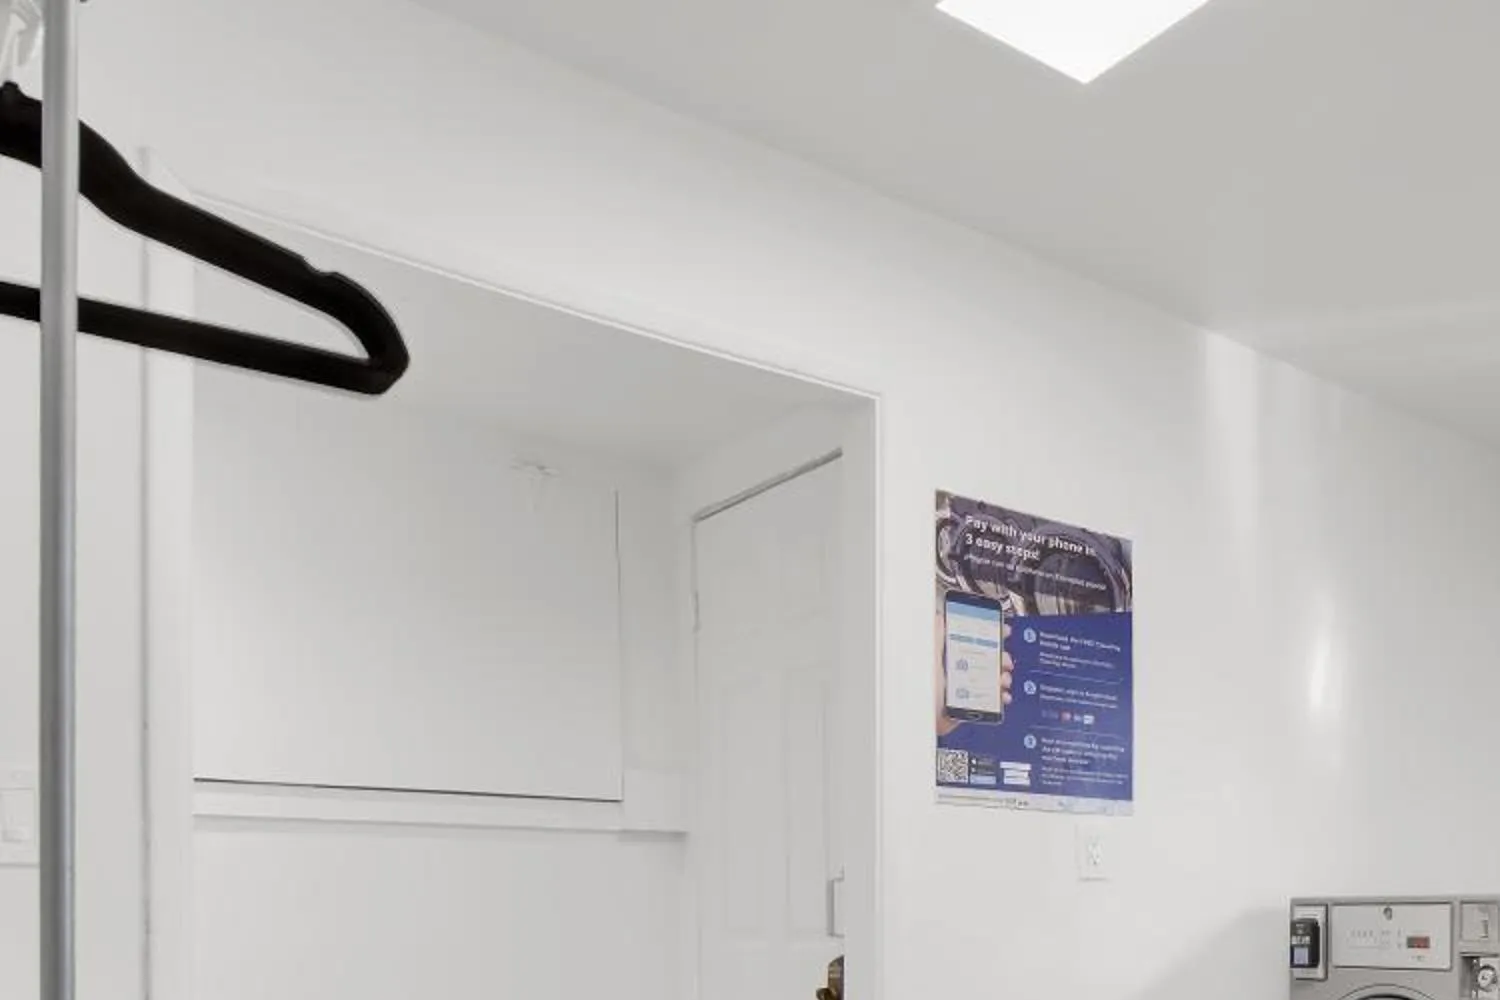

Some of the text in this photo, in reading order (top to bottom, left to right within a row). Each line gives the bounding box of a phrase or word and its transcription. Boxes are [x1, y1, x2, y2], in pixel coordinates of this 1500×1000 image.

[965, 514, 988, 533] Pay
[990, 522, 1017, 538] with
[1018, 528, 1045, 545] your
[965, 532, 973, 545] 3
[975, 537, 1003, 555] easy
